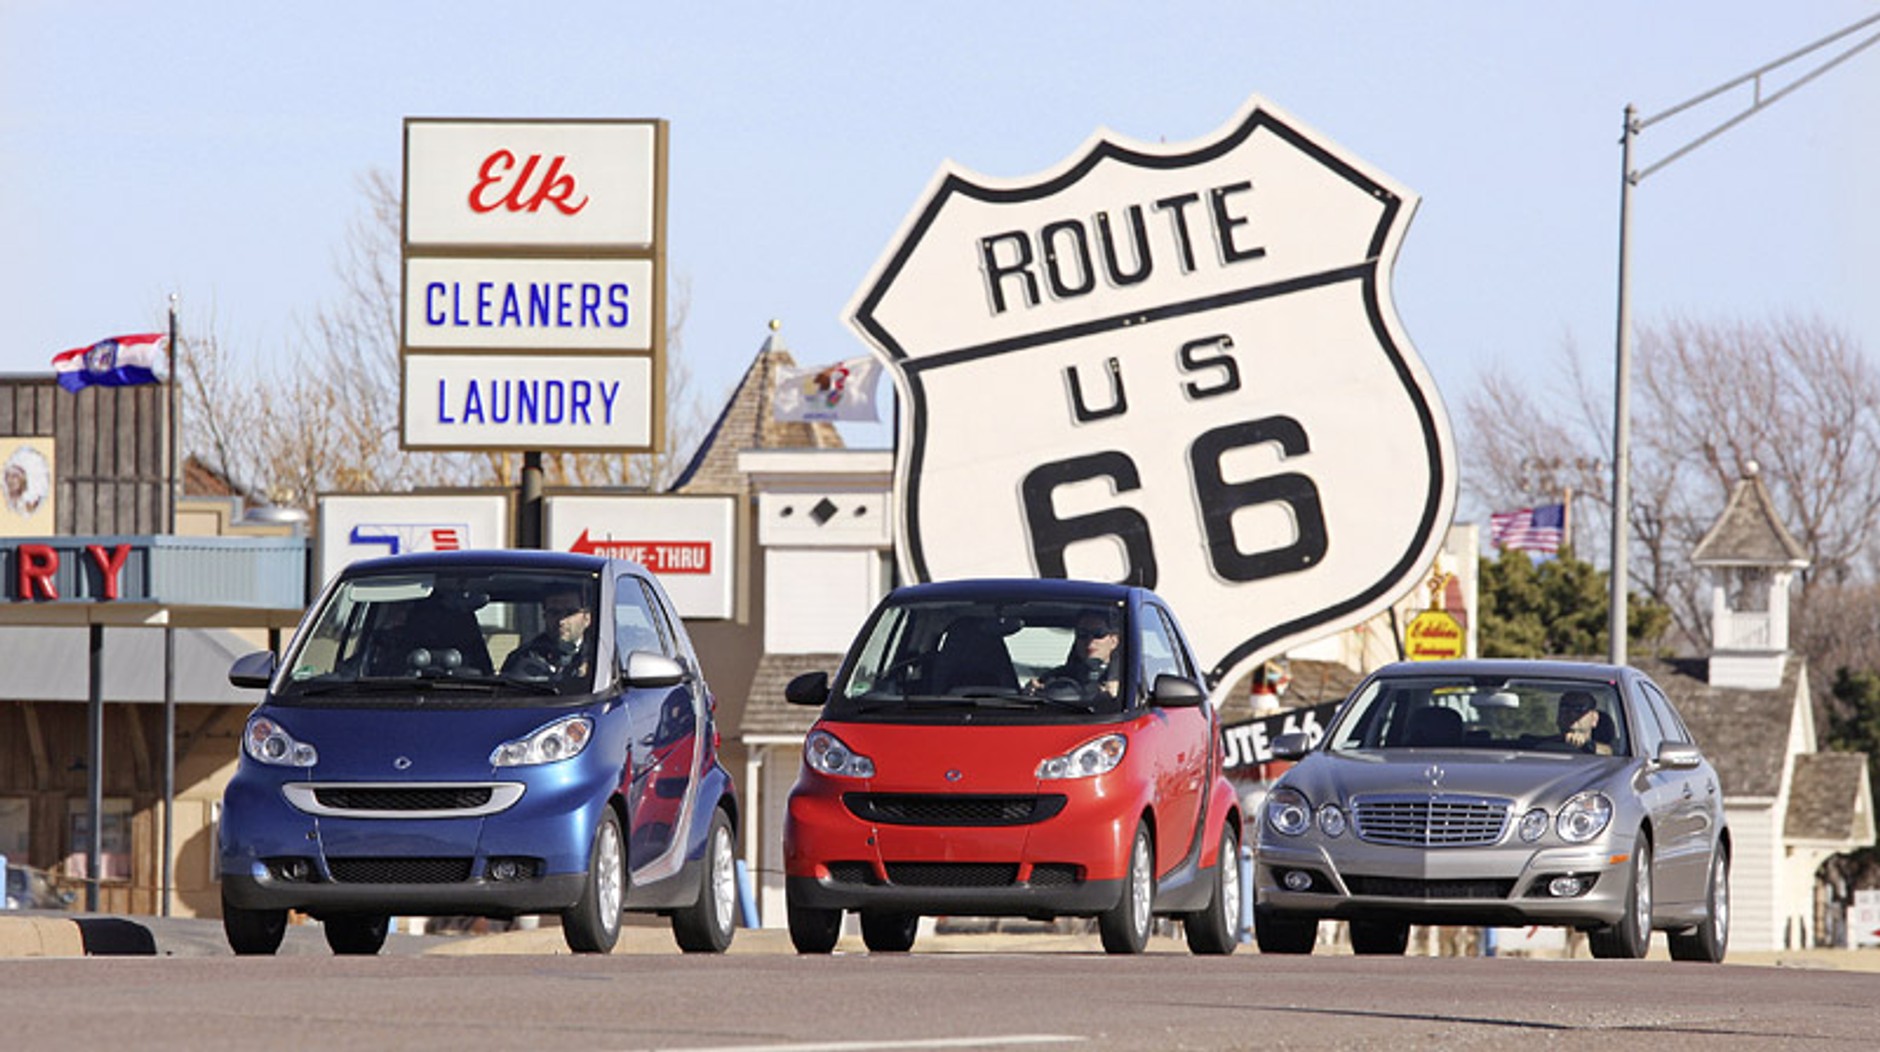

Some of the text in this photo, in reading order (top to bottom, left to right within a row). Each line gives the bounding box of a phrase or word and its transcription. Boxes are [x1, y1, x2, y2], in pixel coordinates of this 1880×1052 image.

[469, 149, 589, 216] Elk
[979, 180, 1266, 314] ROUTE
[425, 282, 629, 328] CLEANERS
[438, 379, 620, 425] LAUNDRY
[1020, 415, 1329, 590] 66
